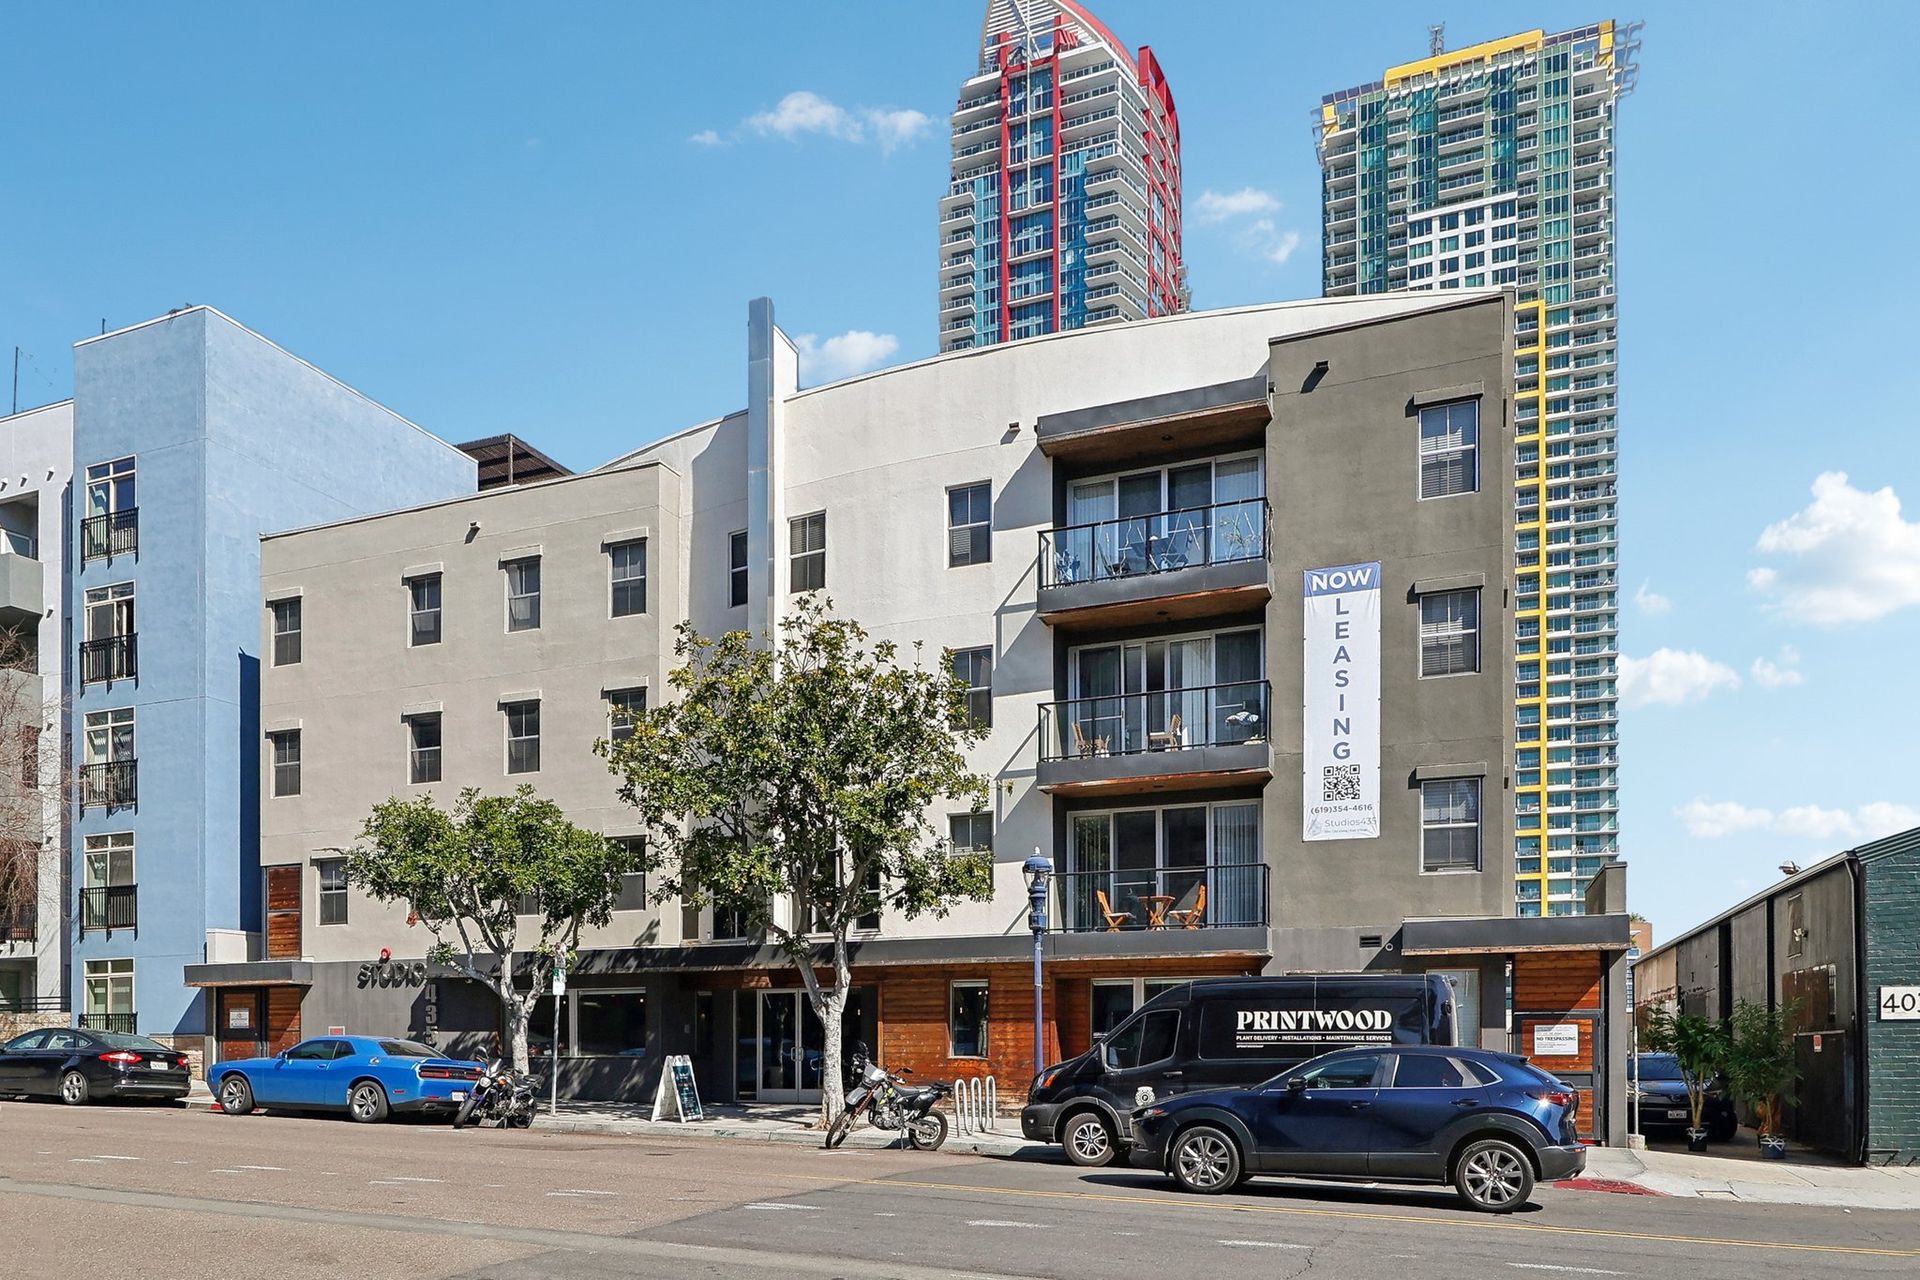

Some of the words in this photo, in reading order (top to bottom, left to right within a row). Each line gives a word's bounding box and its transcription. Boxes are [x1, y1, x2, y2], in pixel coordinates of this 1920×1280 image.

[1312, 568, 1372, 591] NOW
[1332, 597, 1351, 760] LEASING
[1310, 804, 1373, 815] (619)354-4616
[1882, 993, 1920, 1013] 40
[1236, 1010, 1392, 1030] PRINTWOOD
